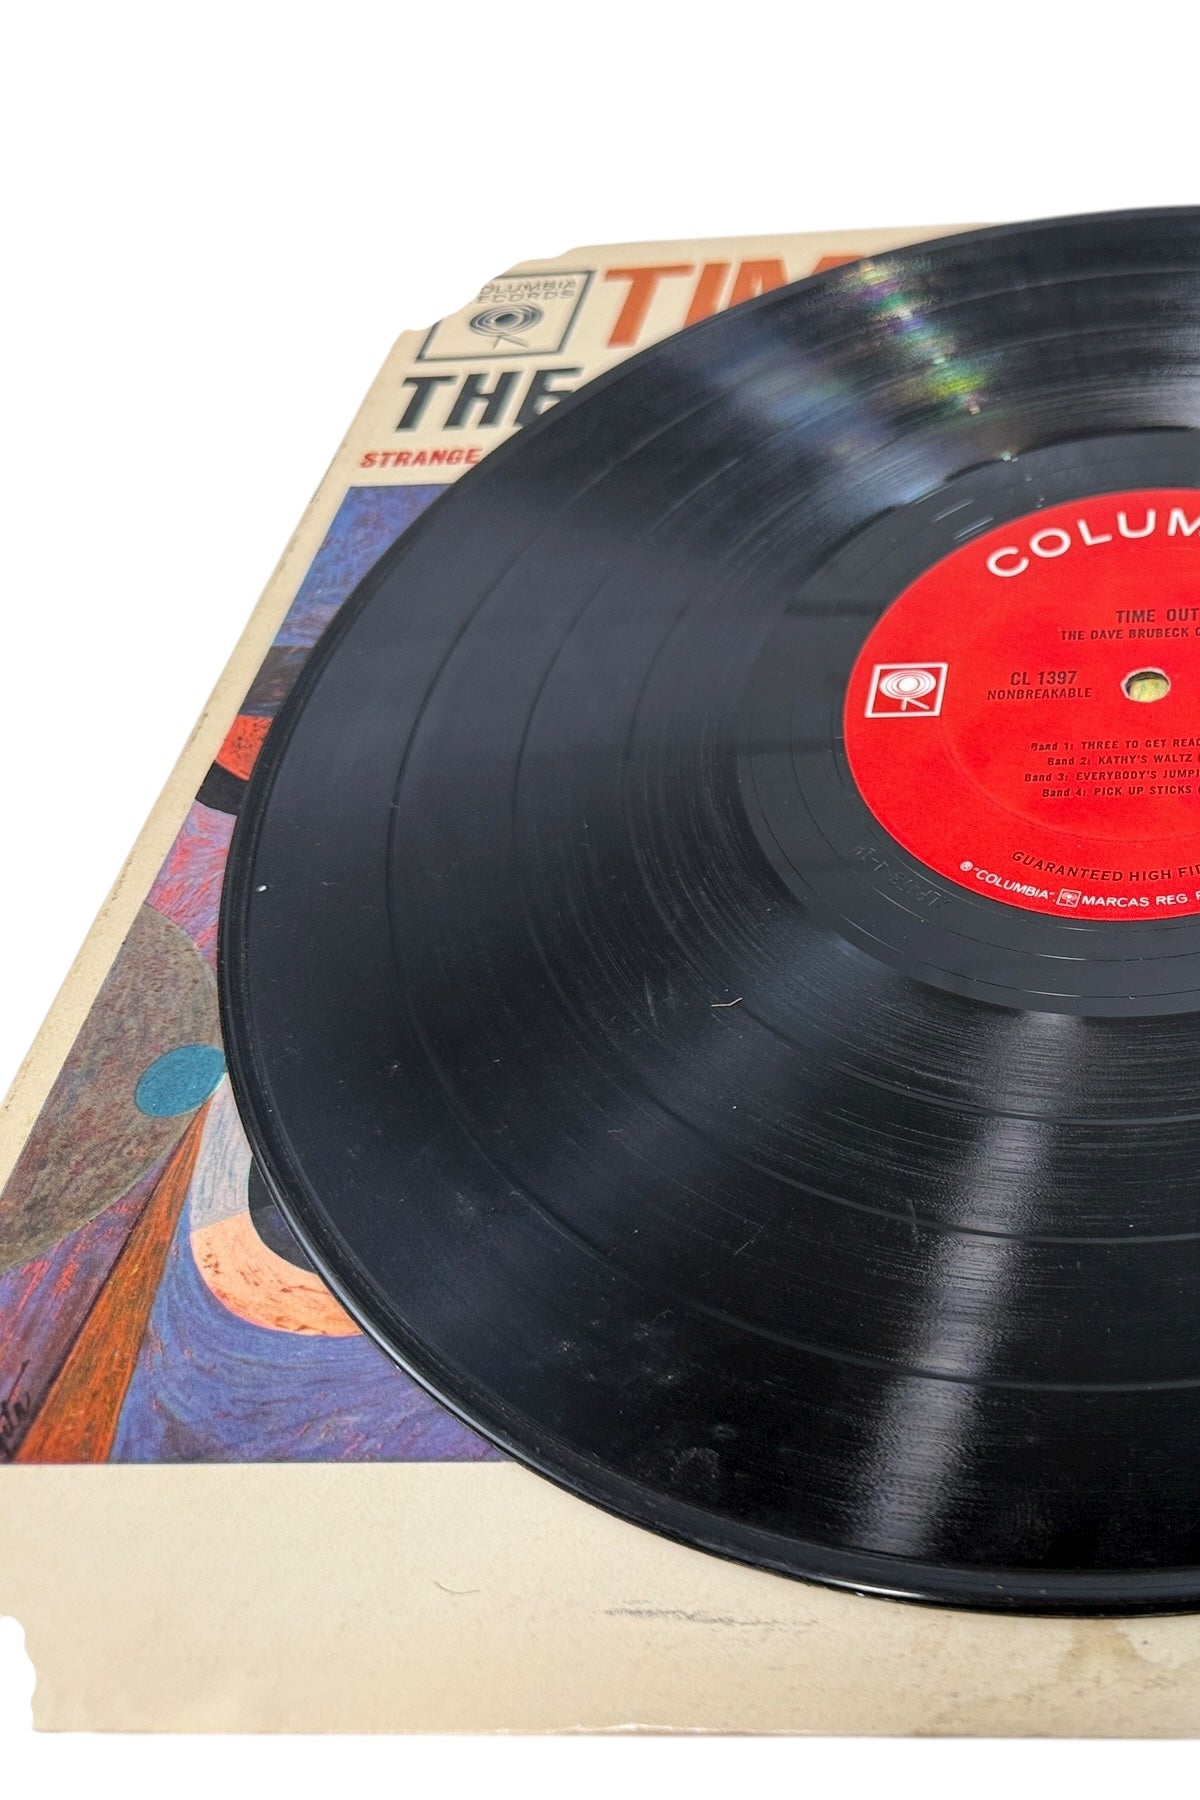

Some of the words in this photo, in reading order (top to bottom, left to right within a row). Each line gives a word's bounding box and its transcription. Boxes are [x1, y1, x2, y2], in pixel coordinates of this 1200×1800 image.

[479, 277, 576, 295] OLUMBIA
[474, 289, 574, 304] ECORDS
[395, 367, 582, 432] THE
[360, 448, 482, 468] STRANGE
[1116, 609, 1156, 624] TIME
[1166, 607, 1200, 622] OUT
[1060, 630, 1085, 641] THE
[1090, 628, 1124, 640] DAVE
[1128, 626, 1189, 639] BRUBECK
[1010, 671, 1031, 686] CL
[1038, 670, 1077, 685] 1397
[987, 687, 1092, 701] NONBREAKABLE
[1031, 742, 1059, 751] Band
[1064, 742, 1074, 751] 1:
[1081, 740, 1119, 750] THREE
[1125, 740, 1139, 749] TO
[1145, 739, 1166, 748] GET
[1047, 757, 1075, 766] Band
[1080, 757, 1091, 765] 2:
[1098, 755, 1148, 764] KATHY'S
[1154, 753, 1192, 763] WALTZ
[1024, 773, 1052, 782] Band
[1057, 772, 1068, 781] 3:
[1076, 770, 1157, 780] EVERYBODY'S
[1042, 788, 1070, 797] Band
[1075, 788, 1086, 796] 4:
[1094, 787, 1122, 796] PICK
[1128, 787, 1144, 795] UP
[1149, 785, 1192, 794] STICKS
[1012, 851, 1123, 882] GUARANTEED
[1129, 869, 1171, 882] HIGH
[1081, 895, 1150, 908] MARCAS
